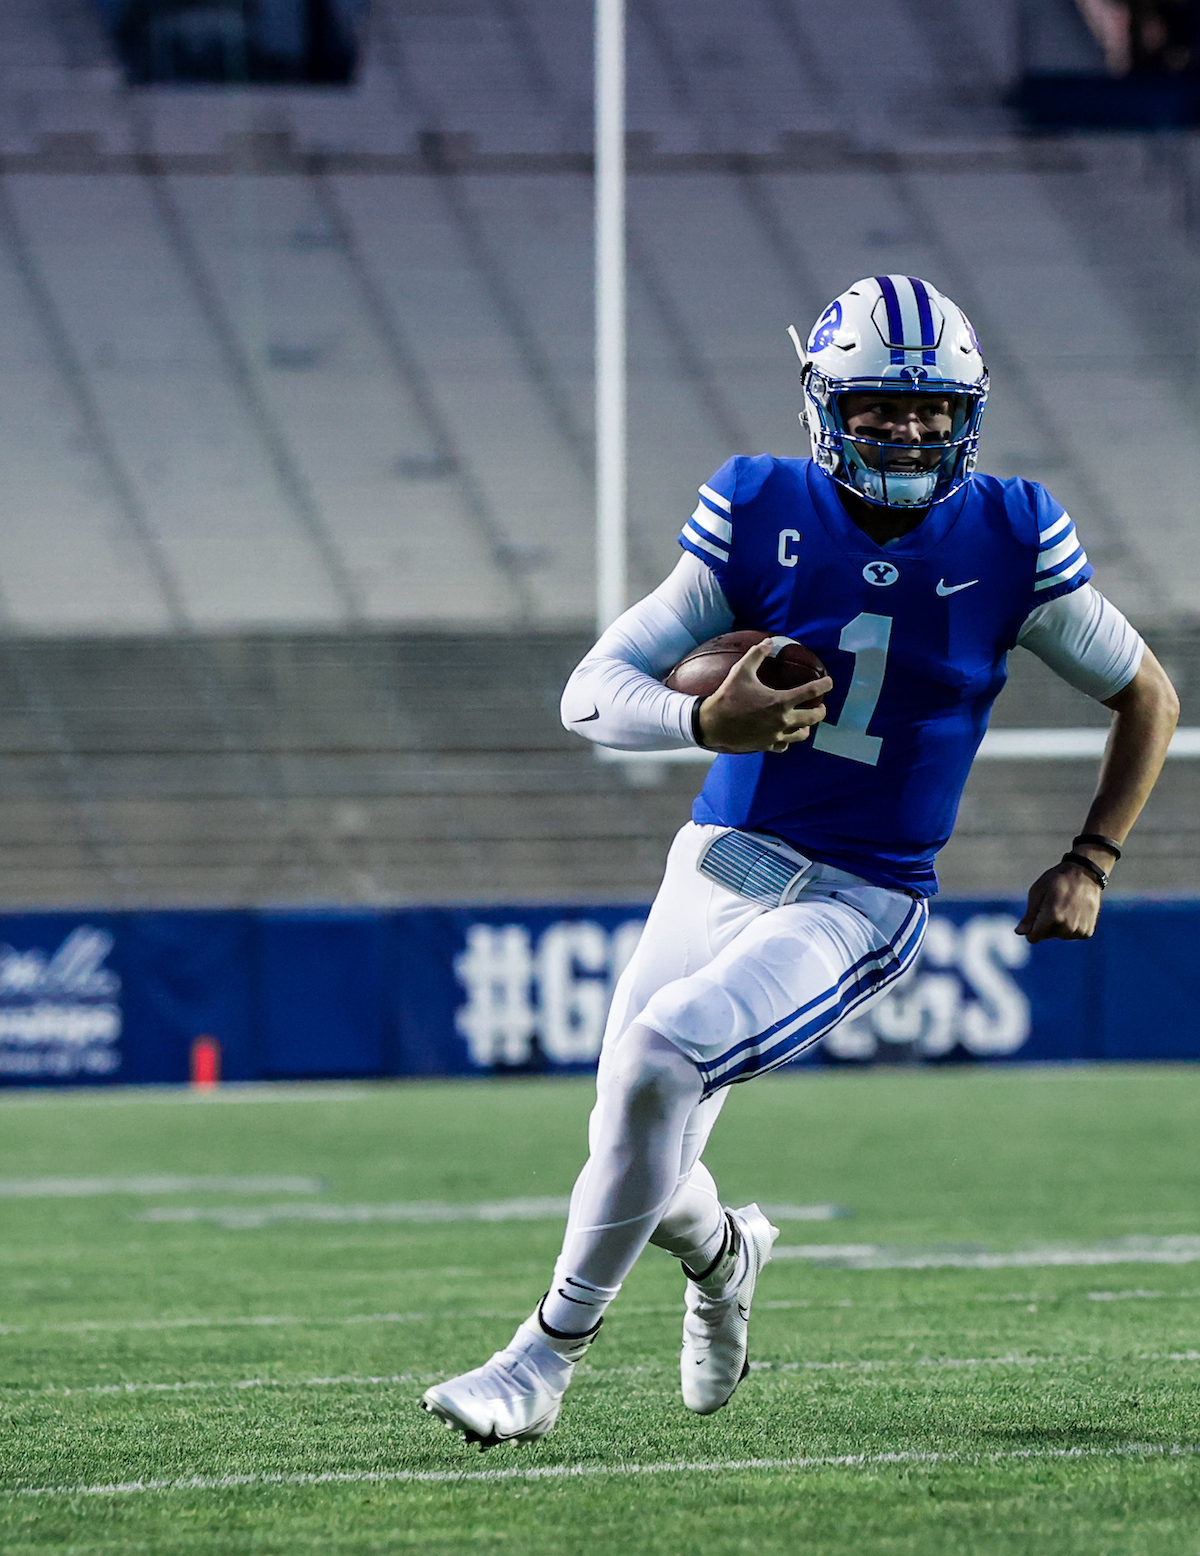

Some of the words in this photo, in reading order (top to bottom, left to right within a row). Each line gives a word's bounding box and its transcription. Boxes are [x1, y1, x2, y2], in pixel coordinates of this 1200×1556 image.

[778, 528, 801, 568] C
[866, 563, 898, 585] Y
[812, 611, 893, 766] 1
